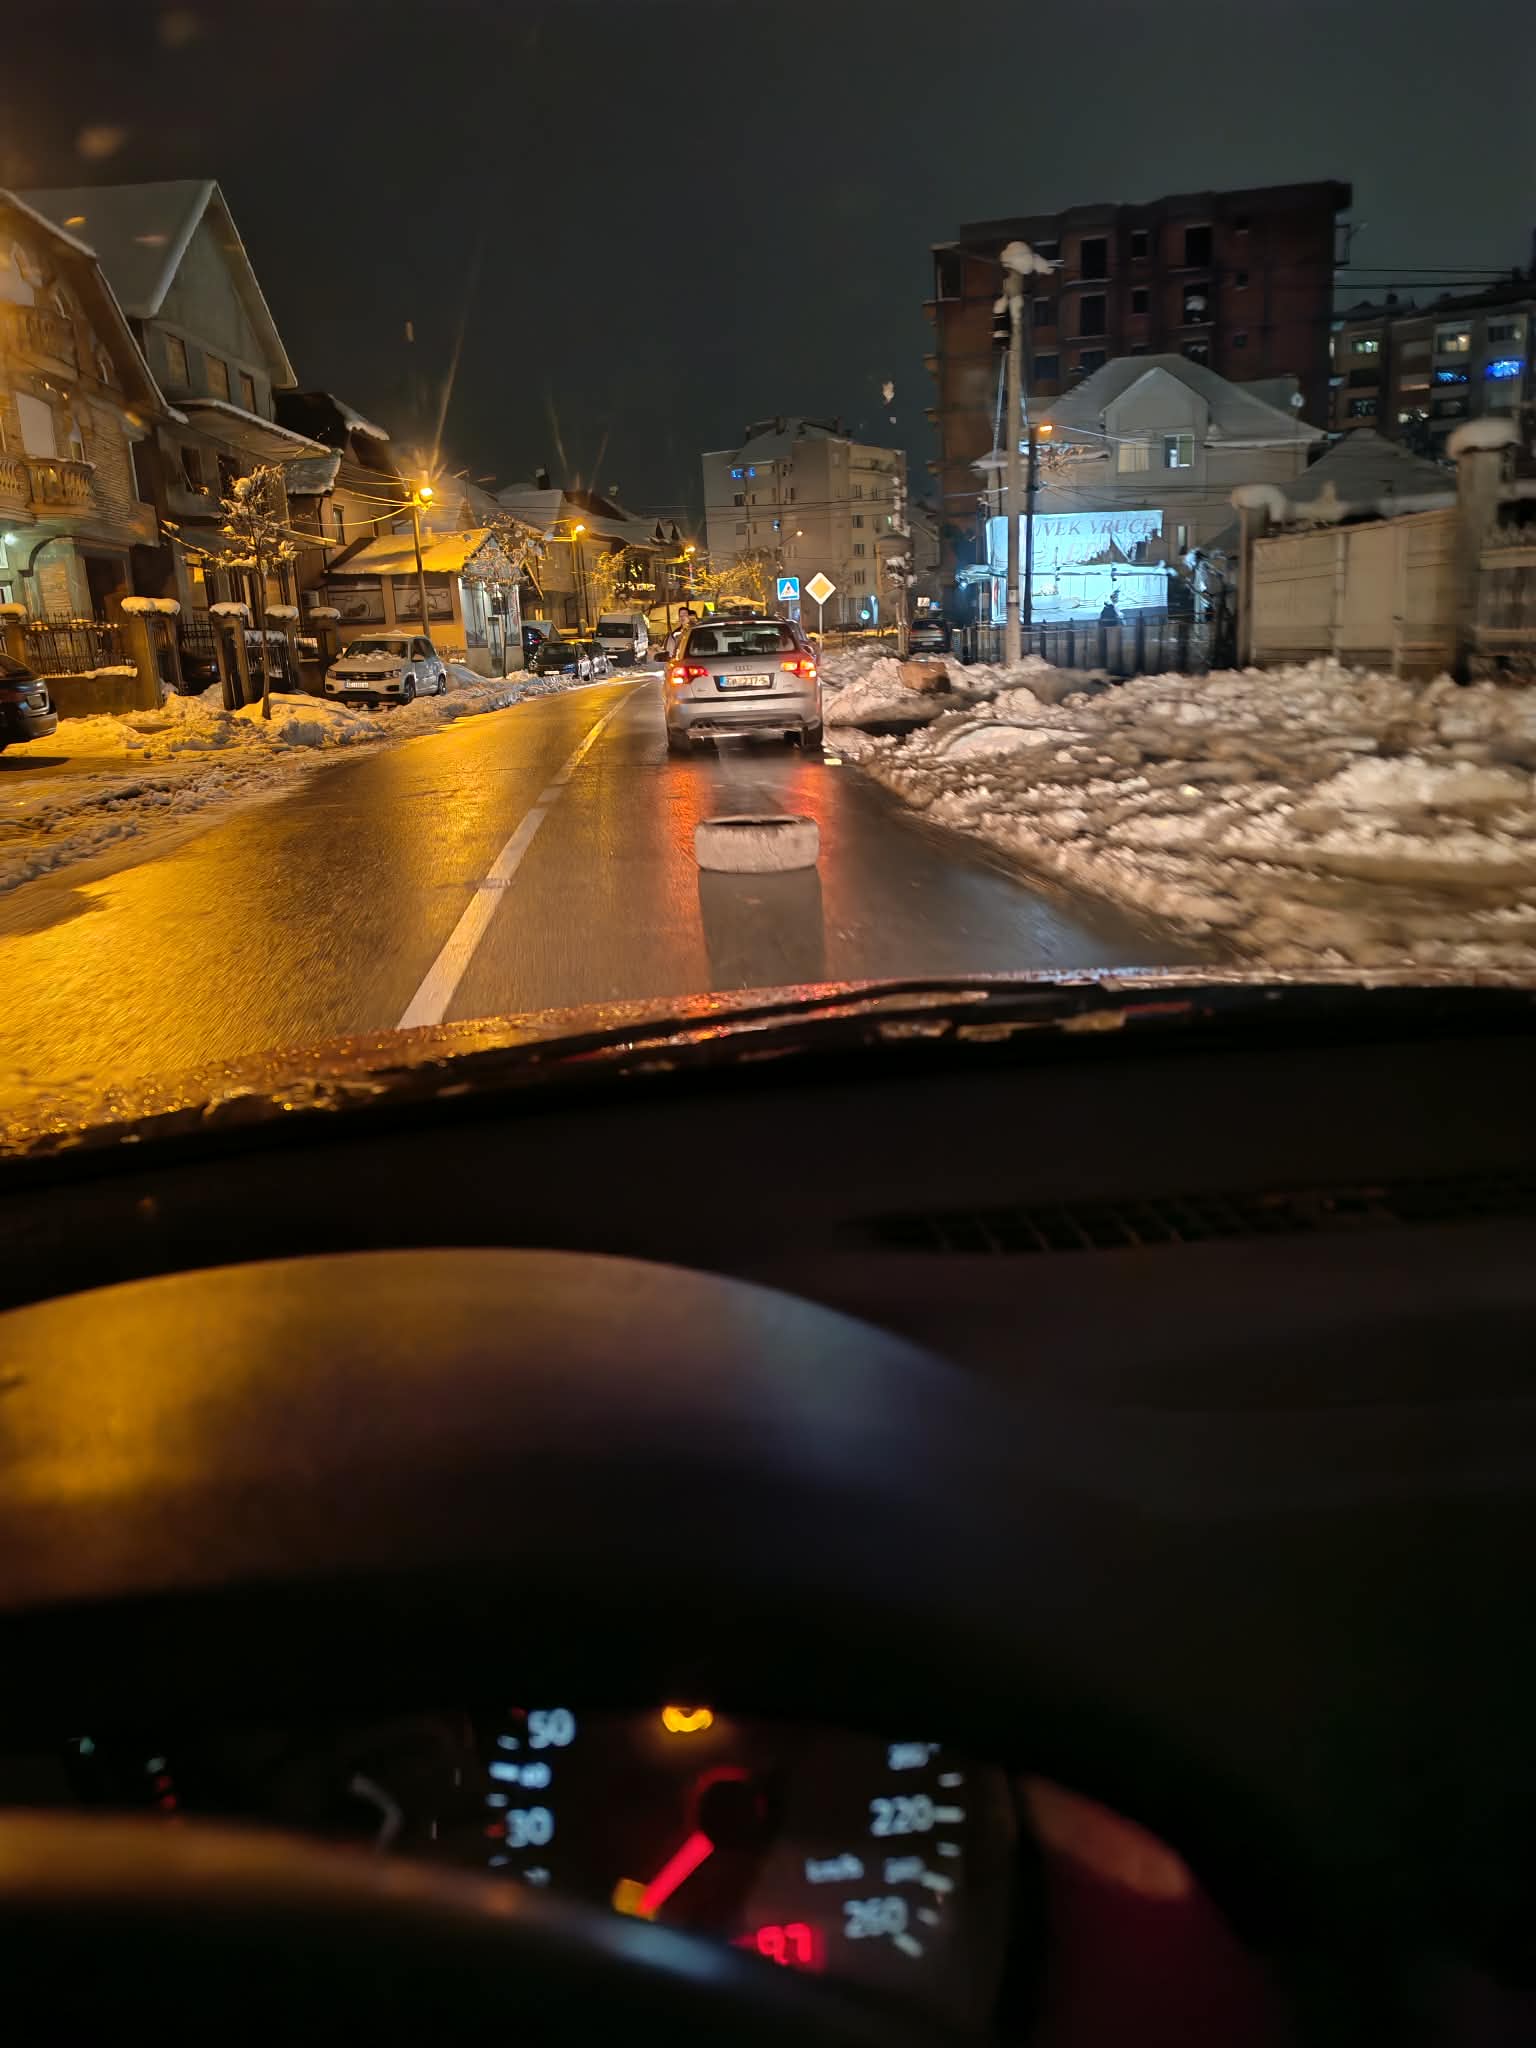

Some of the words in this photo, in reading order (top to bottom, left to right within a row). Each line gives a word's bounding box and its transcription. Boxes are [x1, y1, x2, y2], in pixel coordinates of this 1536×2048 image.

[528, 1707, 576, 1749] 50
[505, 1806, 555, 1848] 30
[869, 1794, 935, 1837] 220
